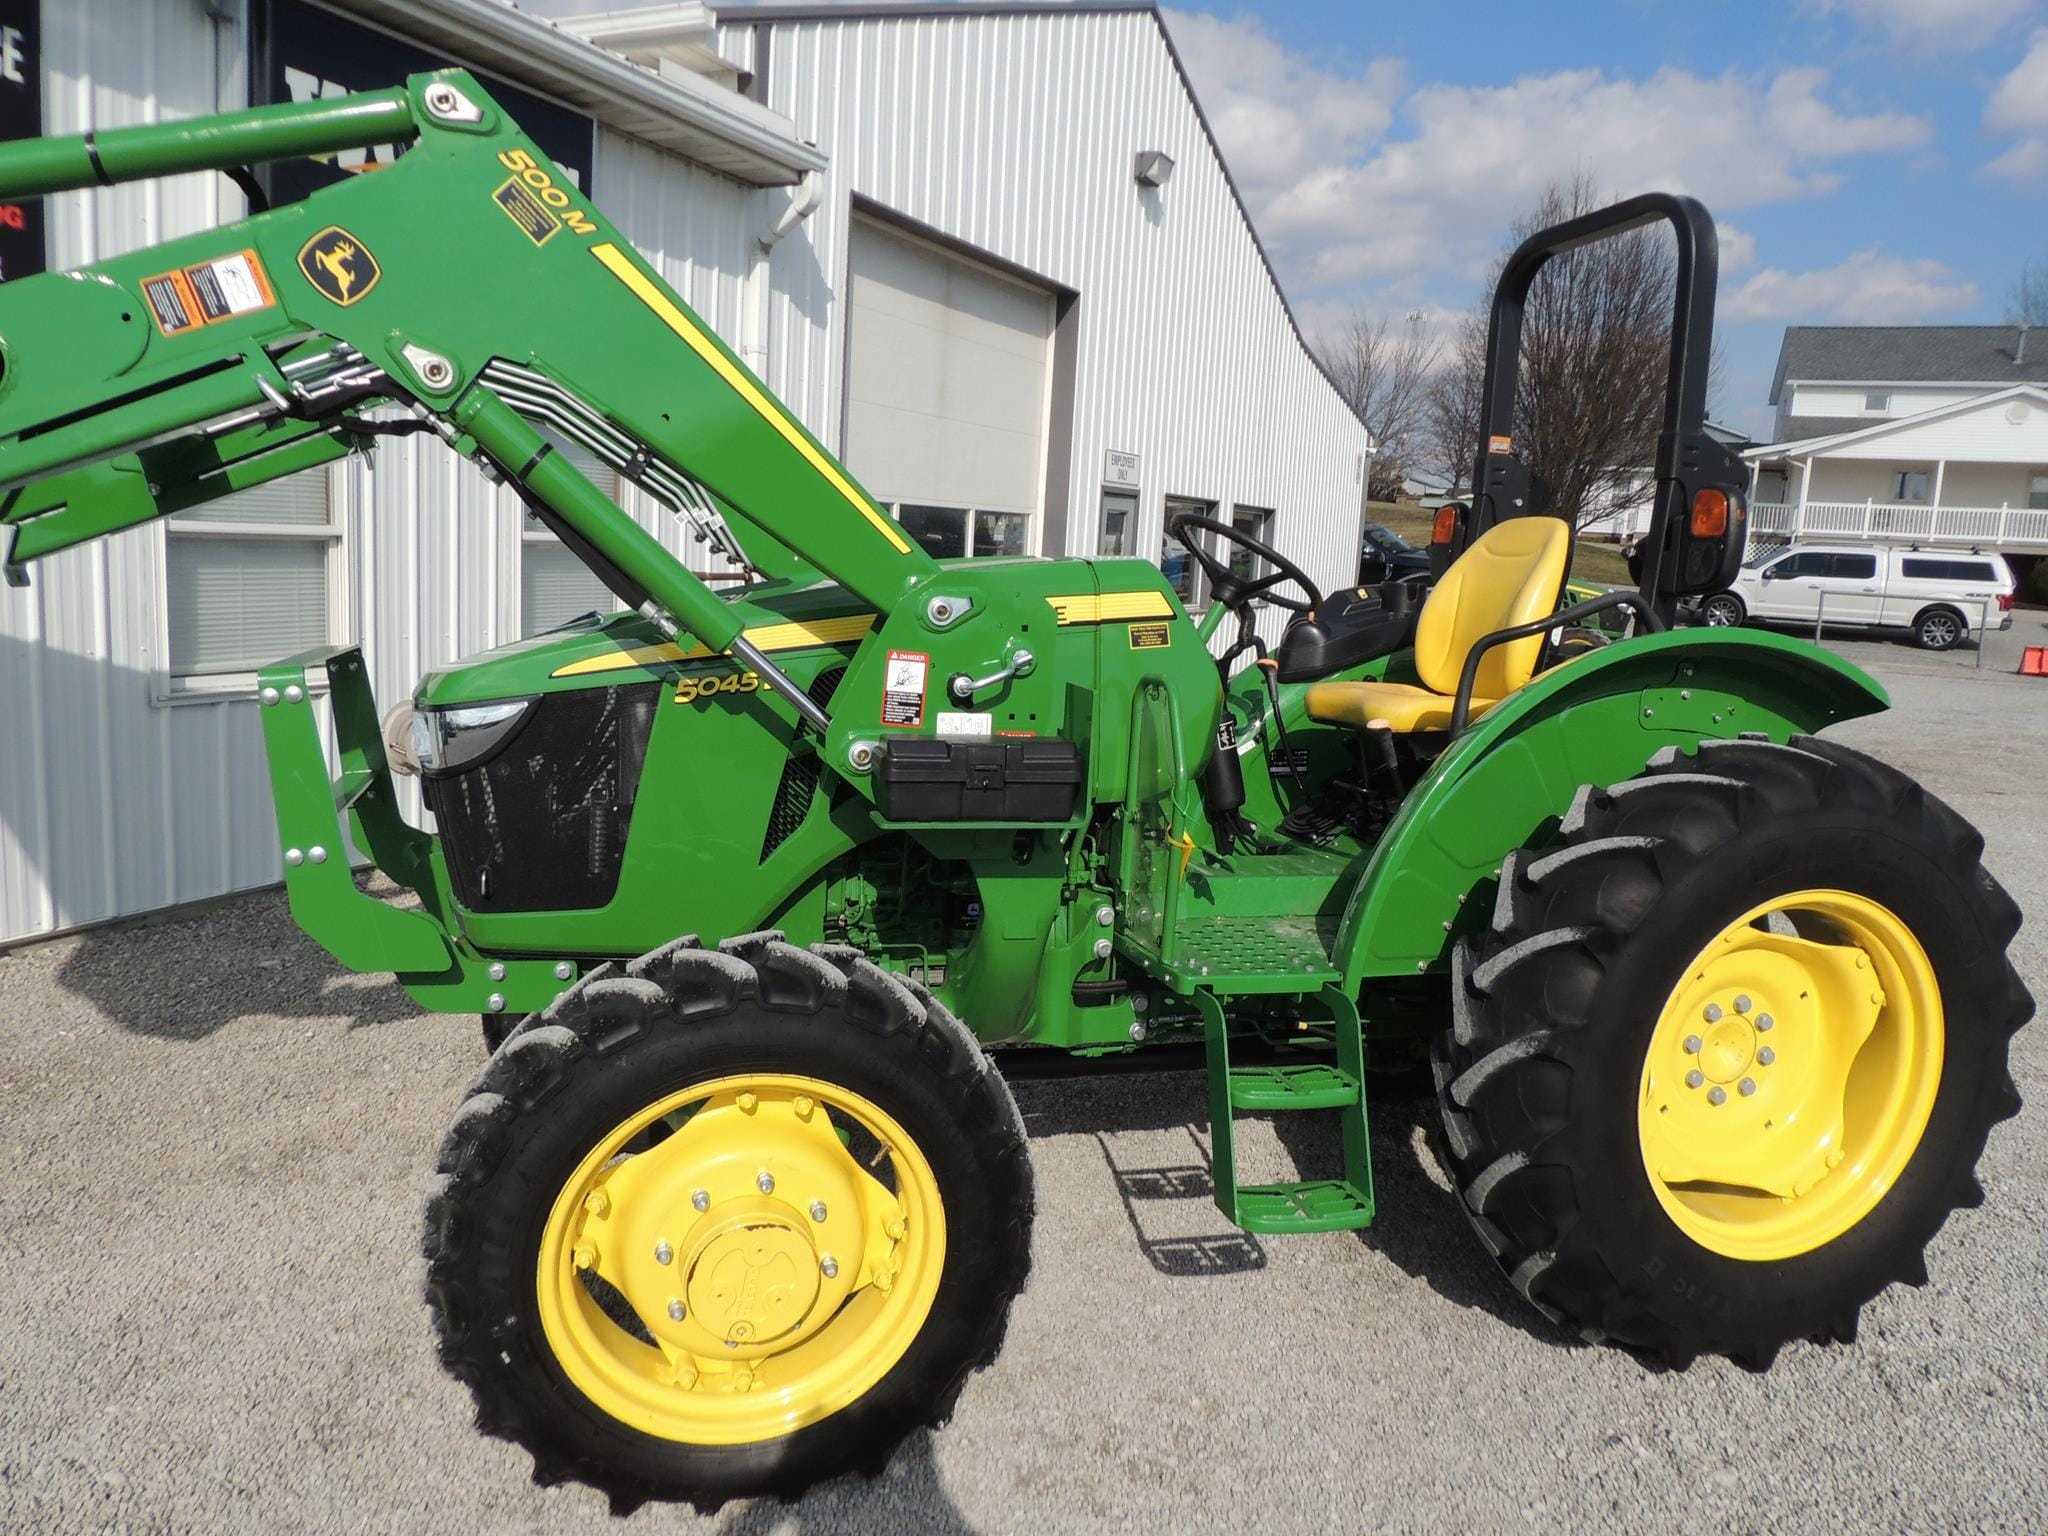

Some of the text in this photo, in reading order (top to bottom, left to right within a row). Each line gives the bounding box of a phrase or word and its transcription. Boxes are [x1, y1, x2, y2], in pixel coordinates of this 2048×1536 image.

[497, 148, 570, 209] 500
[559, 209, 598, 236] M
[899, 653, 925, 662] DANGER
[674, 671, 773, 703] 5045
